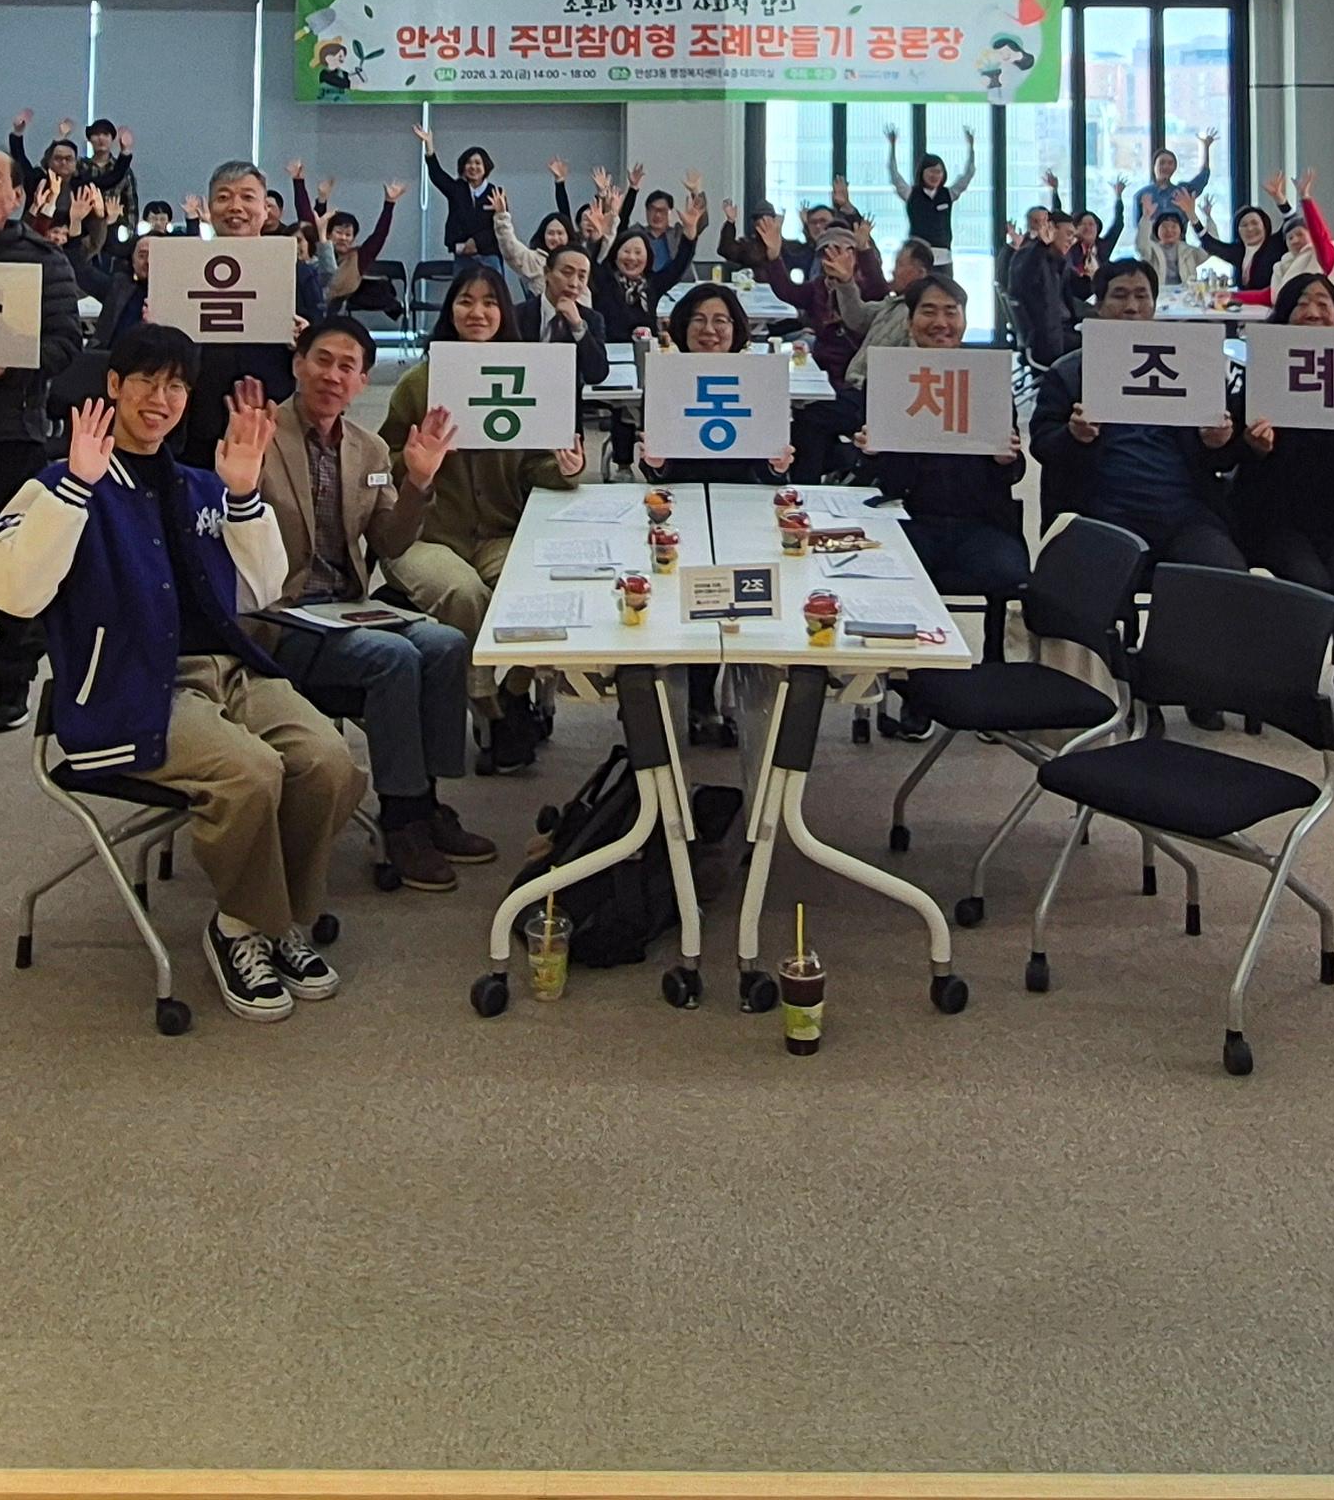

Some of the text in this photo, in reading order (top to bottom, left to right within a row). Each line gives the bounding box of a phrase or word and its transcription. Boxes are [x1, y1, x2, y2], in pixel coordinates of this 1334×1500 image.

[396, 24, 964, 61] 안성시 주민참여형 조례만들기 공론장
[460, 69, 486, 80] 2026.
[533, 69, 560, 80] 14:00
[570, 69, 597, 80] 18:00
[188, 255, 256, 333] 을
[906, 366, 969, 434] 체
[1122, 344, 1186, 398] 조
[468, 366, 536, 442] 공
[684, 375, 752, 451] 동
[741, 579, 764, 592] 2조
